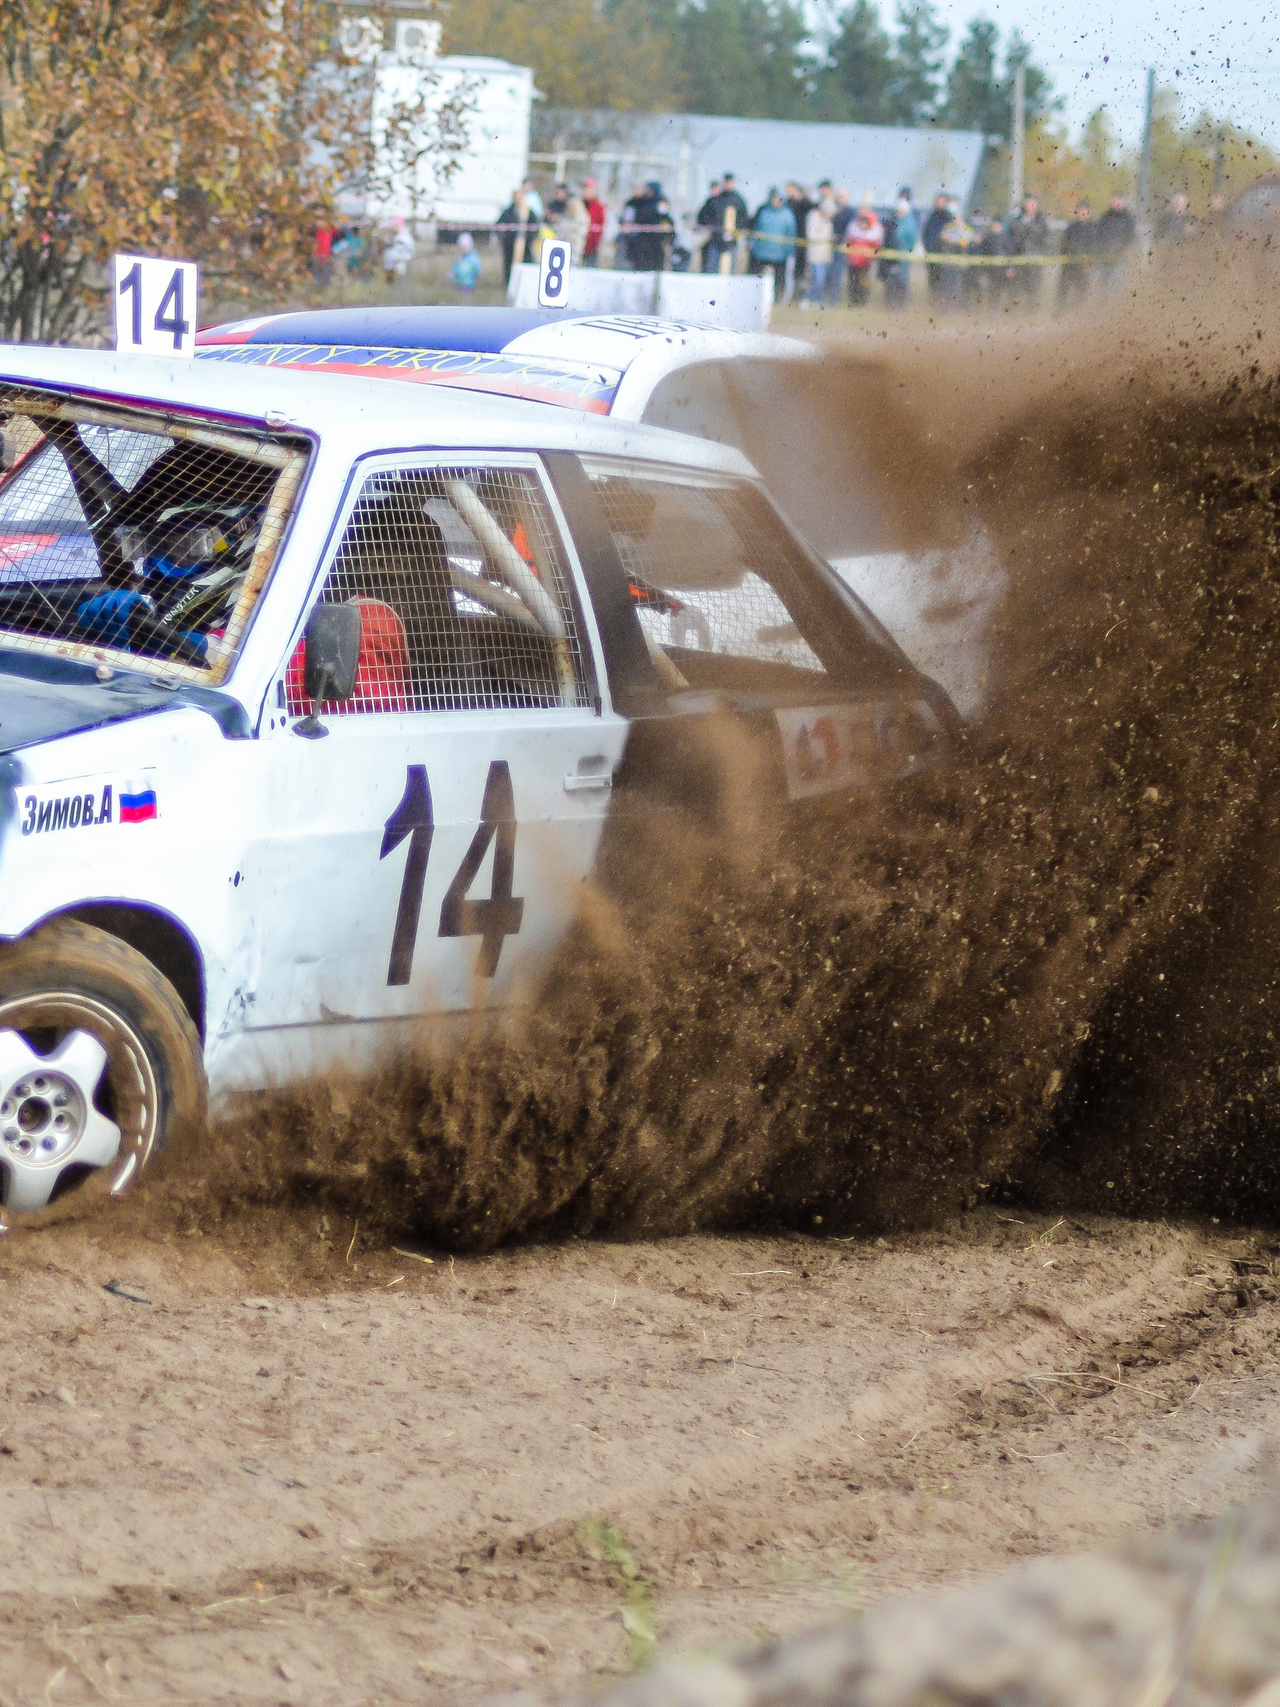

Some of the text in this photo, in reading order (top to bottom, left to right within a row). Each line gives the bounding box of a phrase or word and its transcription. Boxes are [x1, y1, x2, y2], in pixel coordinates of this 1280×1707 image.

[119, 263, 191, 350] 14
[546, 247, 563, 298] 8
[379, 760, 524, 986] 14
